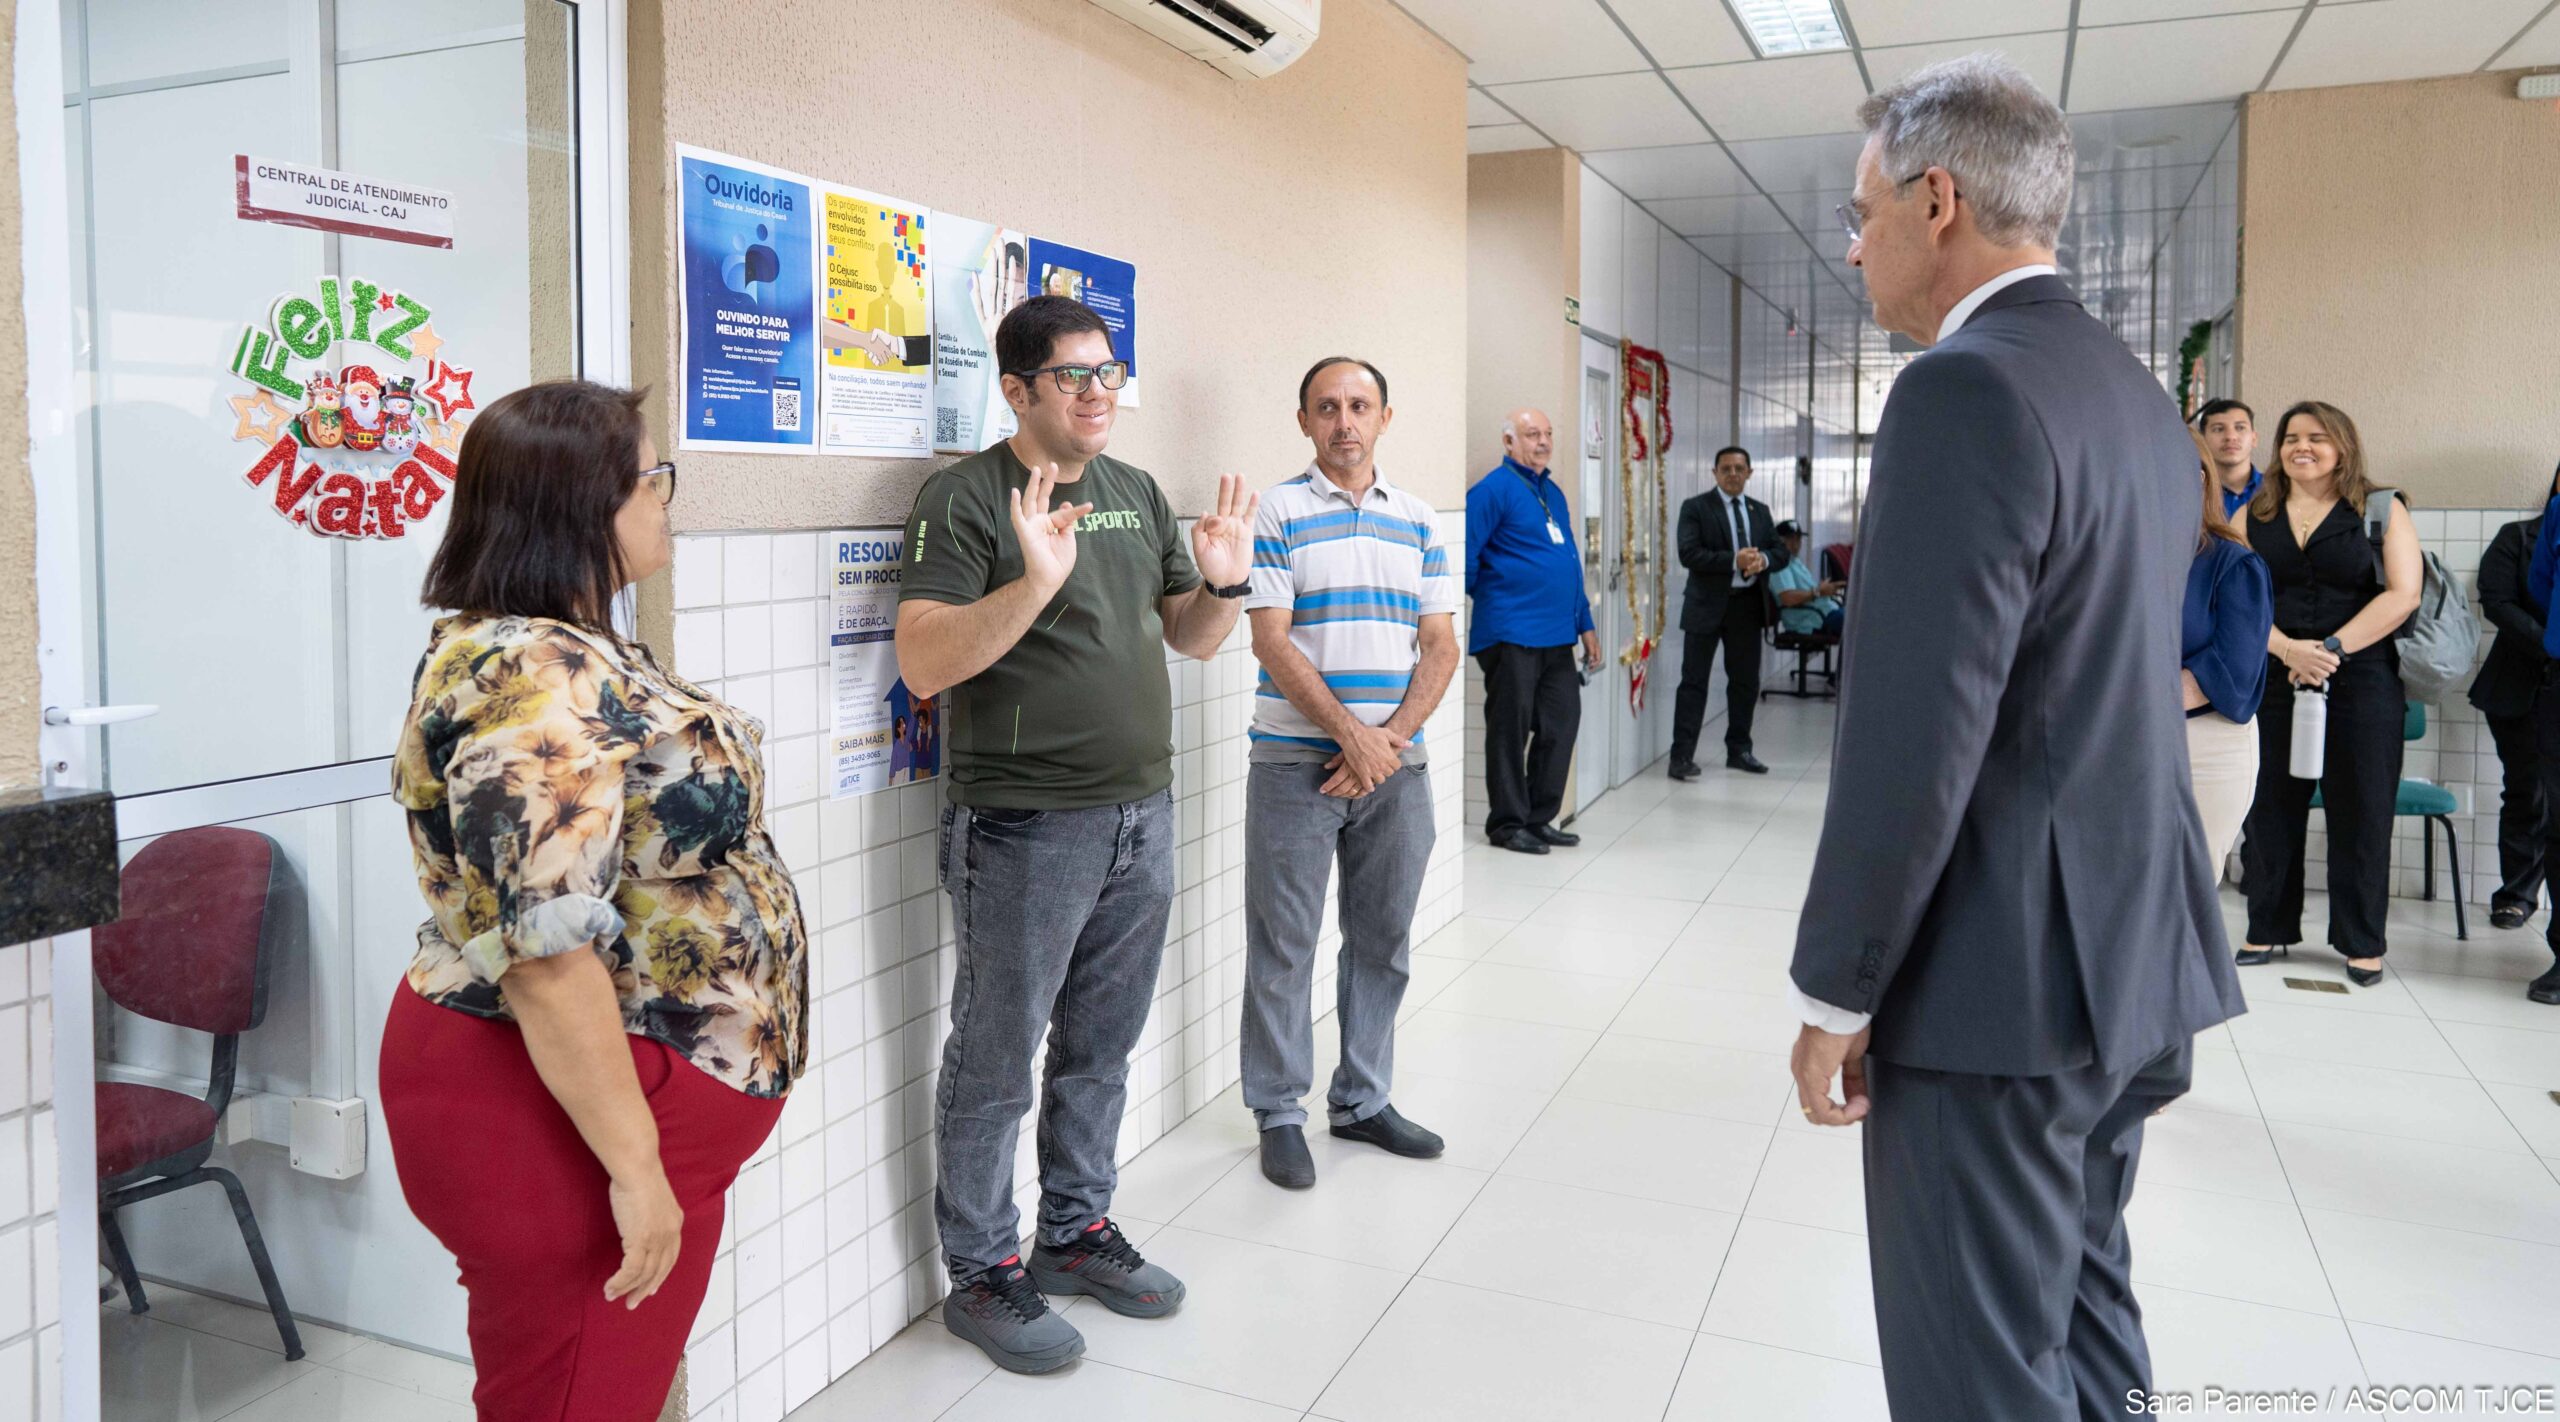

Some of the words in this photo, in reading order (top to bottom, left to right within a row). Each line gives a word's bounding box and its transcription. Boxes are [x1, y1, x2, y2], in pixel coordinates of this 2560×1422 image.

[258, 166, 326, 188] CENTRAL
[331, 178, 349, 193] DE
[354, 184, 448, 209] ATENDIMENTO
[705, 174, 792, 211] Ouvidoria
[712, 199, 734, 209] Tribunal
[744, 206, 762, 216] Justiça
[763, 210, 770, 218] do
[828, 196, 837, 207] Os
[382, 206, 407, 219] CAJ
[828, 210, 866, 226] envolvidos
[828, 222, 866, 238] resolvendo
[830, 234, 846, 245] seus
[847, 238, 875, 252] conflitos
[830, 262, 835, 273] O
[836, 264, 859, 278] Cejusc
[830, 276, 863, 290] possibilita
[864, 282, 877, 293] isso
[716, 310, 760, 325] OUVINDO
[762, 316, 789, 328] PARA
[238, 276, 432, 402] Feliz
[716, 323, 754, 338] MELHOR
[756, 329, 790, 342] SERVIR
[938, 333, 952, 341] Cartilha
[758, 348, 783, 357] Ouvidoria?
[938, 344, 959, 355] Comissão
[960, 348, 966, 356] de
[968, 348, 987, 358] Combate
[944, 356, 963, 367] Assédio
[828, 373, 837, 381] Na
[870, 378, 885, 386] todos
[902, 380, 927, 390] ganhando!
[243, 431, 458, 540] Natal
[918, 520, 928, 539] RUN
[1084, 510, 1141, 532] SPORTS
[914, 540, 925, 562] WILD
[839, 570, 862, 585] SEM
[839, 616, 844, 629] É
[846, 619, 857, 629] DE
[860, 616, 889, 628] GRAÇA.
[840, 738, 864, 751] SAIBA
[866, 734, 885, 746] MAIS
[839, 757, 850, 767] (85)
[851, 750, 881, 763] 3492-9065
[848, 774, 860, 784] TJCE
